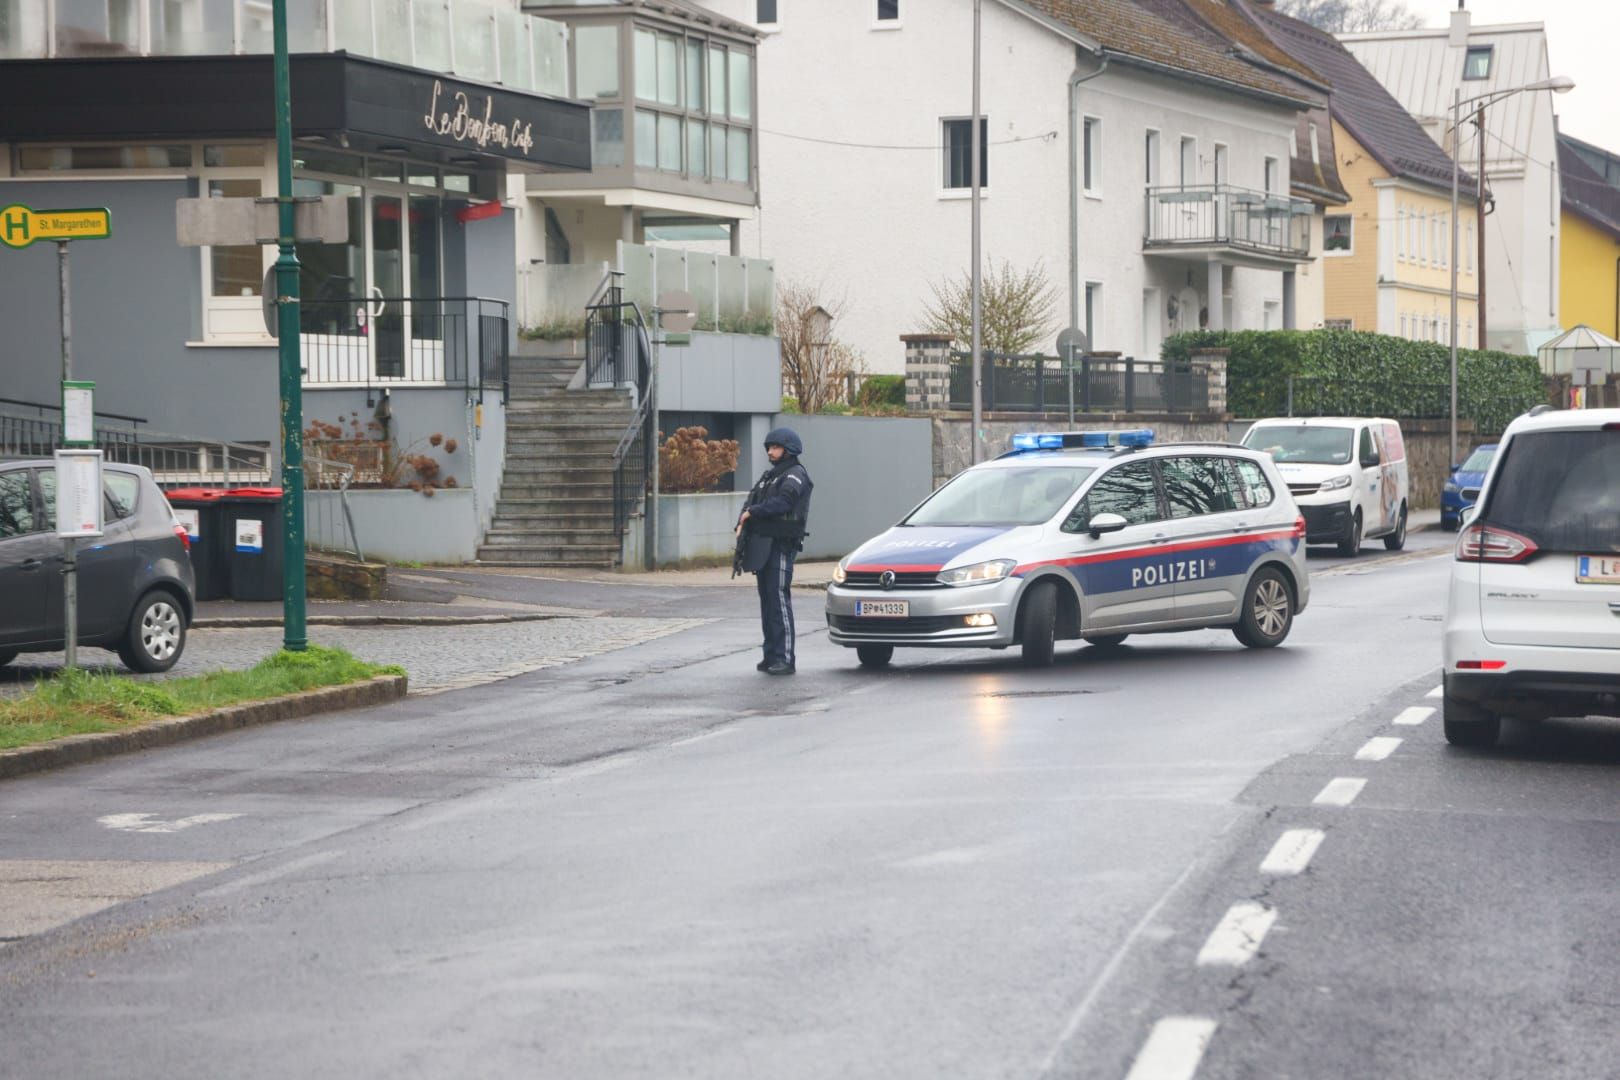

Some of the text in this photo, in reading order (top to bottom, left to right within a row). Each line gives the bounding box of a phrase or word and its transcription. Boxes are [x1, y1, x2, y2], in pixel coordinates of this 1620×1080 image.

[424, 80, 452, 135] Le
[5, 212, 29, 240] H
[39, 217, 102, 232] St. Margarethen
[1132, 559, 1205, 587] POLIZEI
[1601, 559, 1609, 575] L
